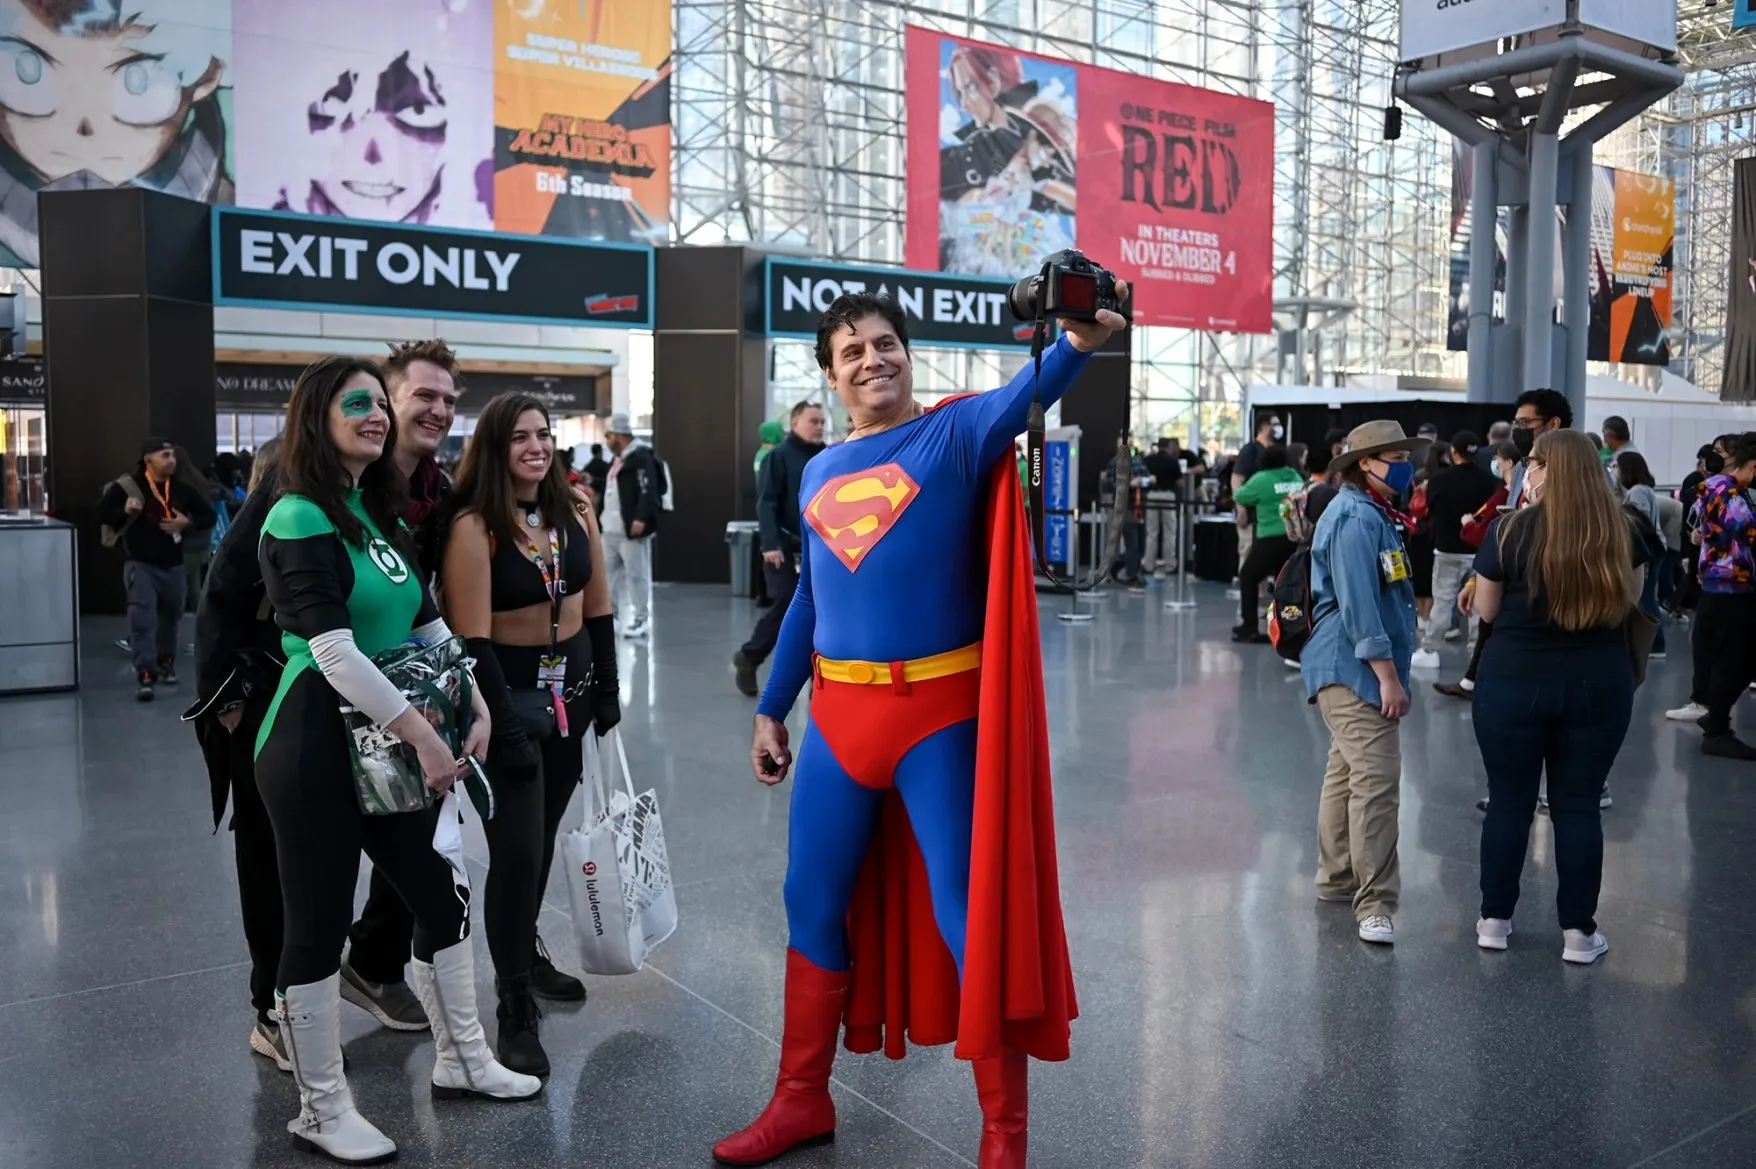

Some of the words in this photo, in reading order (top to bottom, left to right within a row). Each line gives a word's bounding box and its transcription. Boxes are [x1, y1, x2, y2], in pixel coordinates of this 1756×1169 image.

[1120, 103, 1154, 123] ONE
[1158, 110, 1197, 131] PIECE
[508, 129, 656, 168] ACADEMIA
[535, 171, 567, 194] 6th
[570, 175, 632, 201] Season
[1120, 124, 1241, 215] RED
[1138, 224, 1153, 239] IN
[1156, 226, 1219, 247] THEATERS
[240, 229, 368, 280] EXIT
[376, 242, 521, 291] ONLY
[1120, 237, 1221, 273] NOVEMBER
[1224, 251, 1236, 275] 4
[875, 282, 923, 321] N
[933, 288, 1006, 325] EXIT
[1031, 447, 1041, 487] Canon
[586, 879, 604, 937] lululemon
